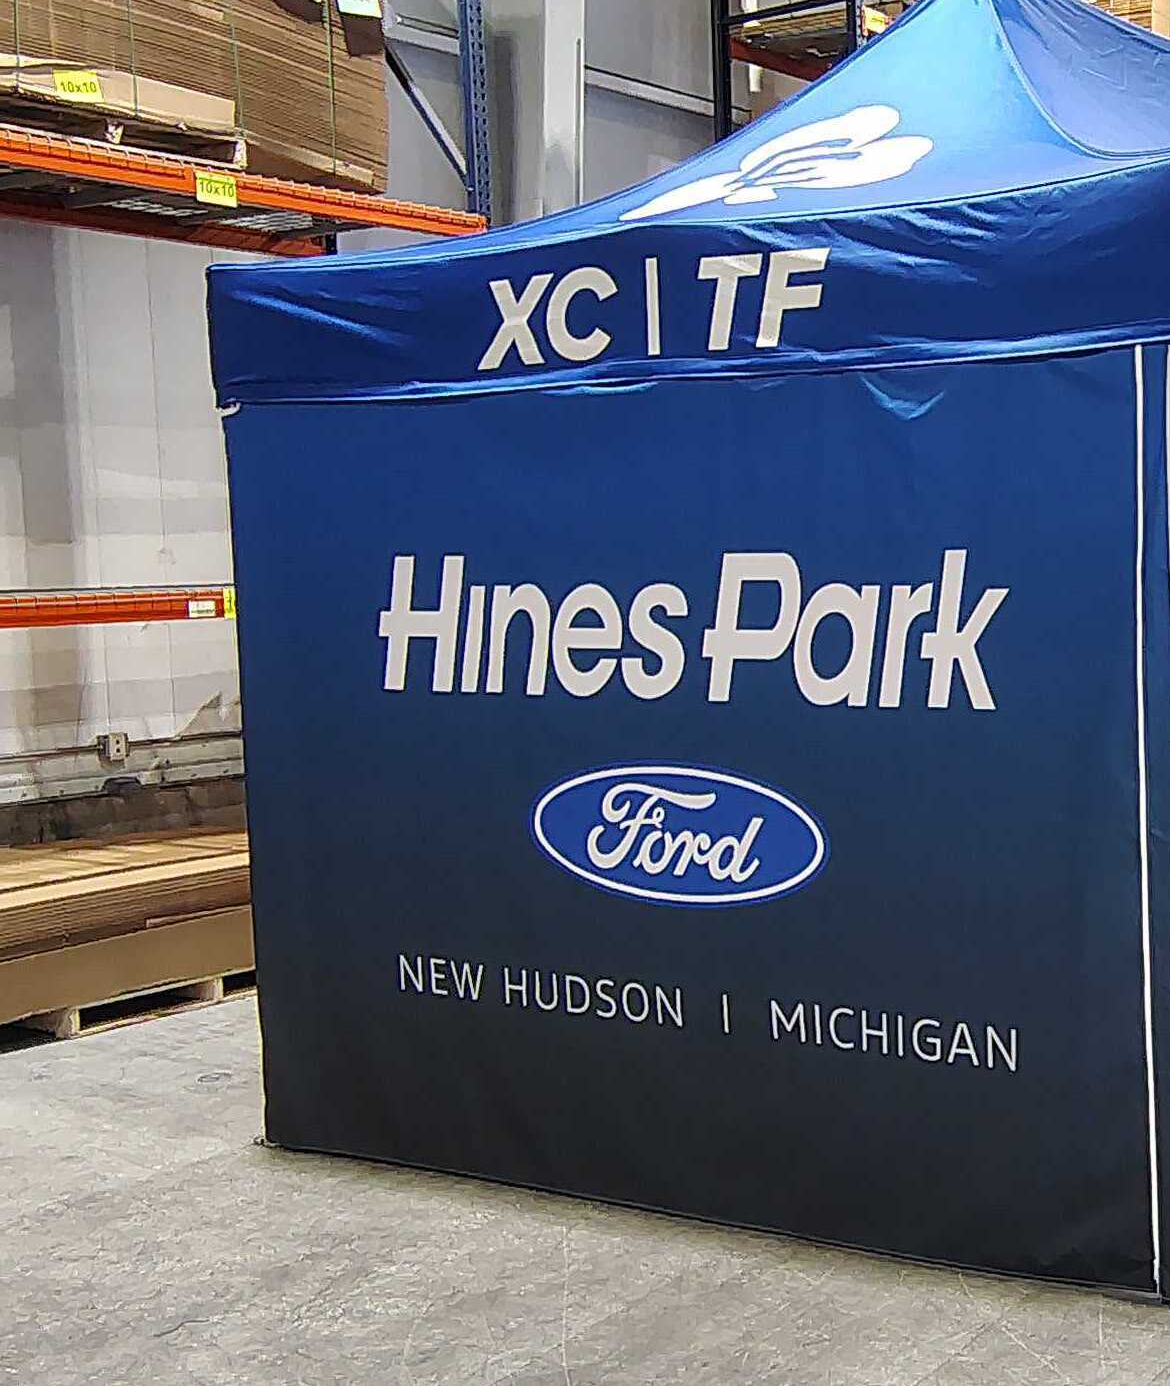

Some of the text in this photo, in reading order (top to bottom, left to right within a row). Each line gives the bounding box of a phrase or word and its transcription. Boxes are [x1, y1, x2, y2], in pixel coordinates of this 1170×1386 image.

[60, 81, 97, 94] 10x10
[199, 179, 235, 198] 10x10
[477, 266, 618, 371] XC
[696, 247, 831, 352] TF
[378, 548, 1010, 711] Hines Park
[586, 781, 764, 883] Ford
[398, 953, 484, 1002] NEW
[503, 967, 684, 1028] HUDSON
[769, 999, 1018, 1073] MICHIGAN
